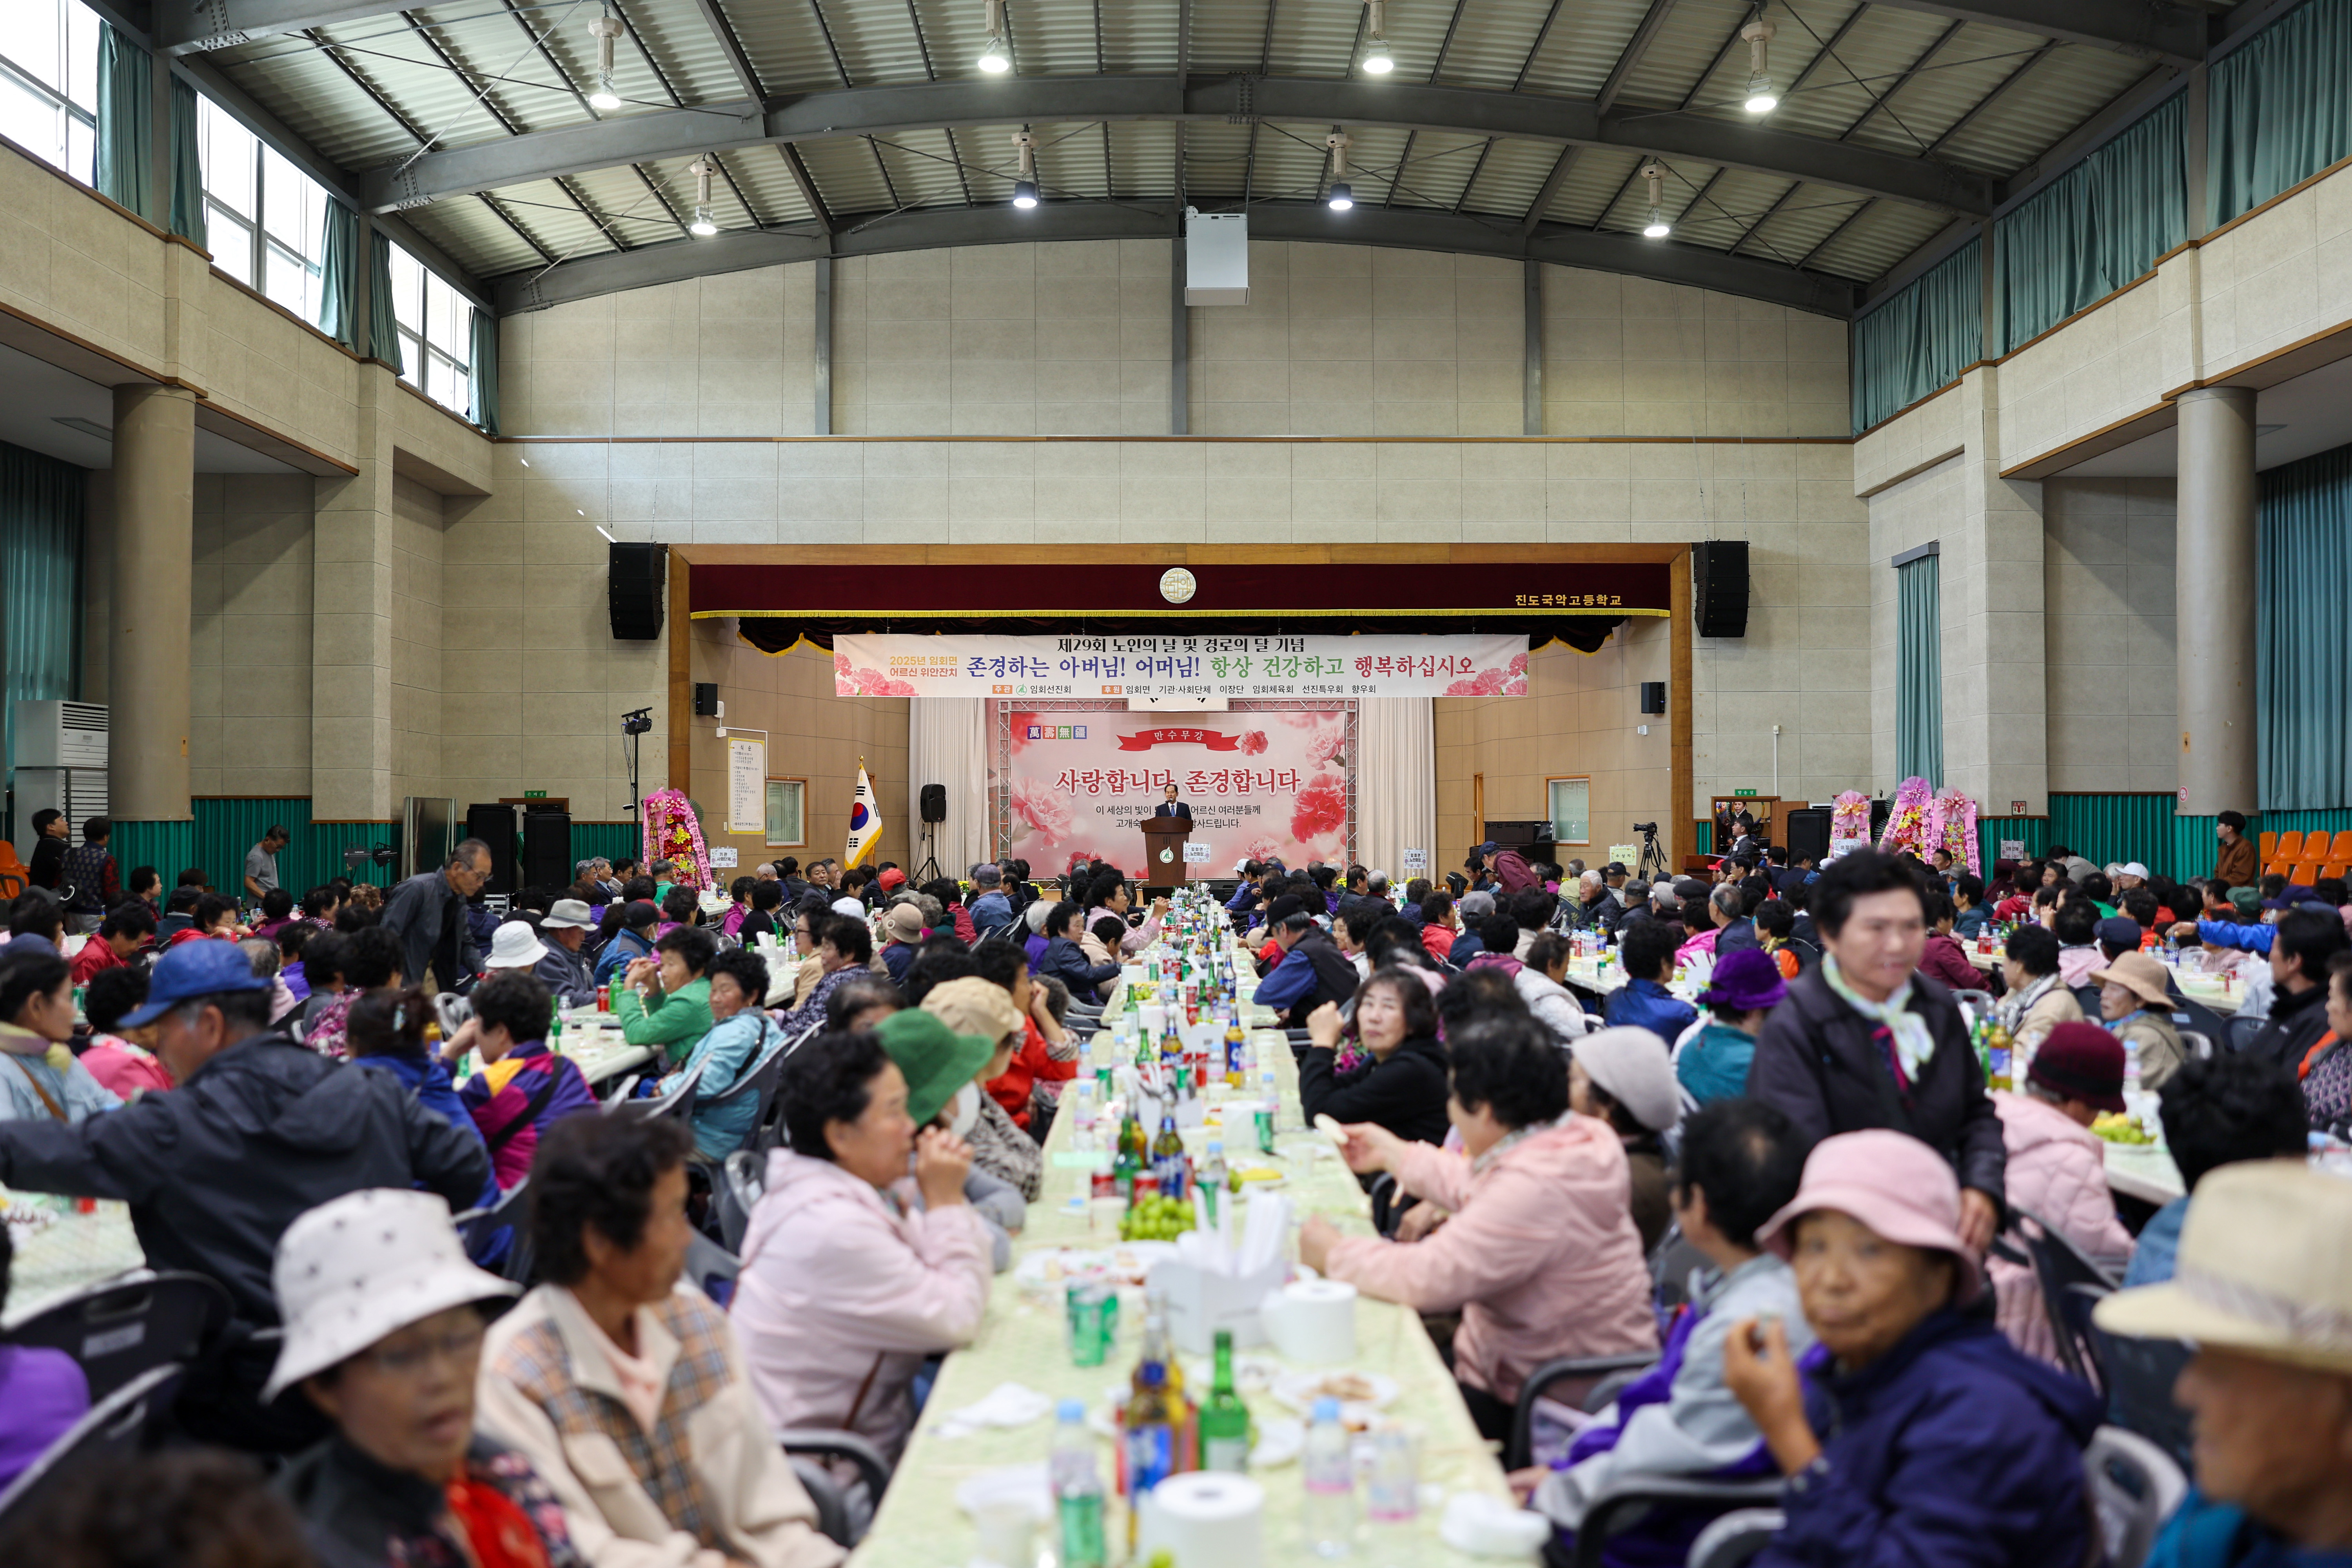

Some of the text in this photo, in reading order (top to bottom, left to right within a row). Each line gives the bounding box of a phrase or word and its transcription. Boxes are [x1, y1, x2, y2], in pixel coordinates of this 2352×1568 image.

[1514, 593, 1624, 607] 진도국악고등학교
[1056, 636, 1305, 654] 제29회 노인의 날 및 경로의 달 기념
[889, 655, 959, 667] 2025년 임회면
[965, 655, 1477, 679] 존경하는 아버님! 어머님! 항상 건강하고 행복하십시오
[889, 667, 959, 678] 어르신 위안잔치
[1029, 684, 1073, 695] 임회선진회
[1125, 684, 1151, 694] 임회면
[1218, 684, 1245, 695] 이장단
[1251, 684, 1295, 695] 임회체육회
[1301, 684, 1345, 695] 선진특우회
[1350, 684, 1377, 695] 향우회
[1028, 726, 1086, 739] 萬壽無疆
[1153, 730, 1205, 741] 만수무강
[1055, 768, 1301, 795] 사랑합니다 존경합니다
[1096, 804, 1105, 816] 이
[1106, 804, 1133, 816] 세상의
[1134, 804, 1152, 816] 빛이
[1191, 804, 1216, 816] 어르신
[1218, 804, 1261, 816] 여러분들께
[1923, 808, 1932, 818] 祝
[1115, 818, 1150, 829] 고개숙
